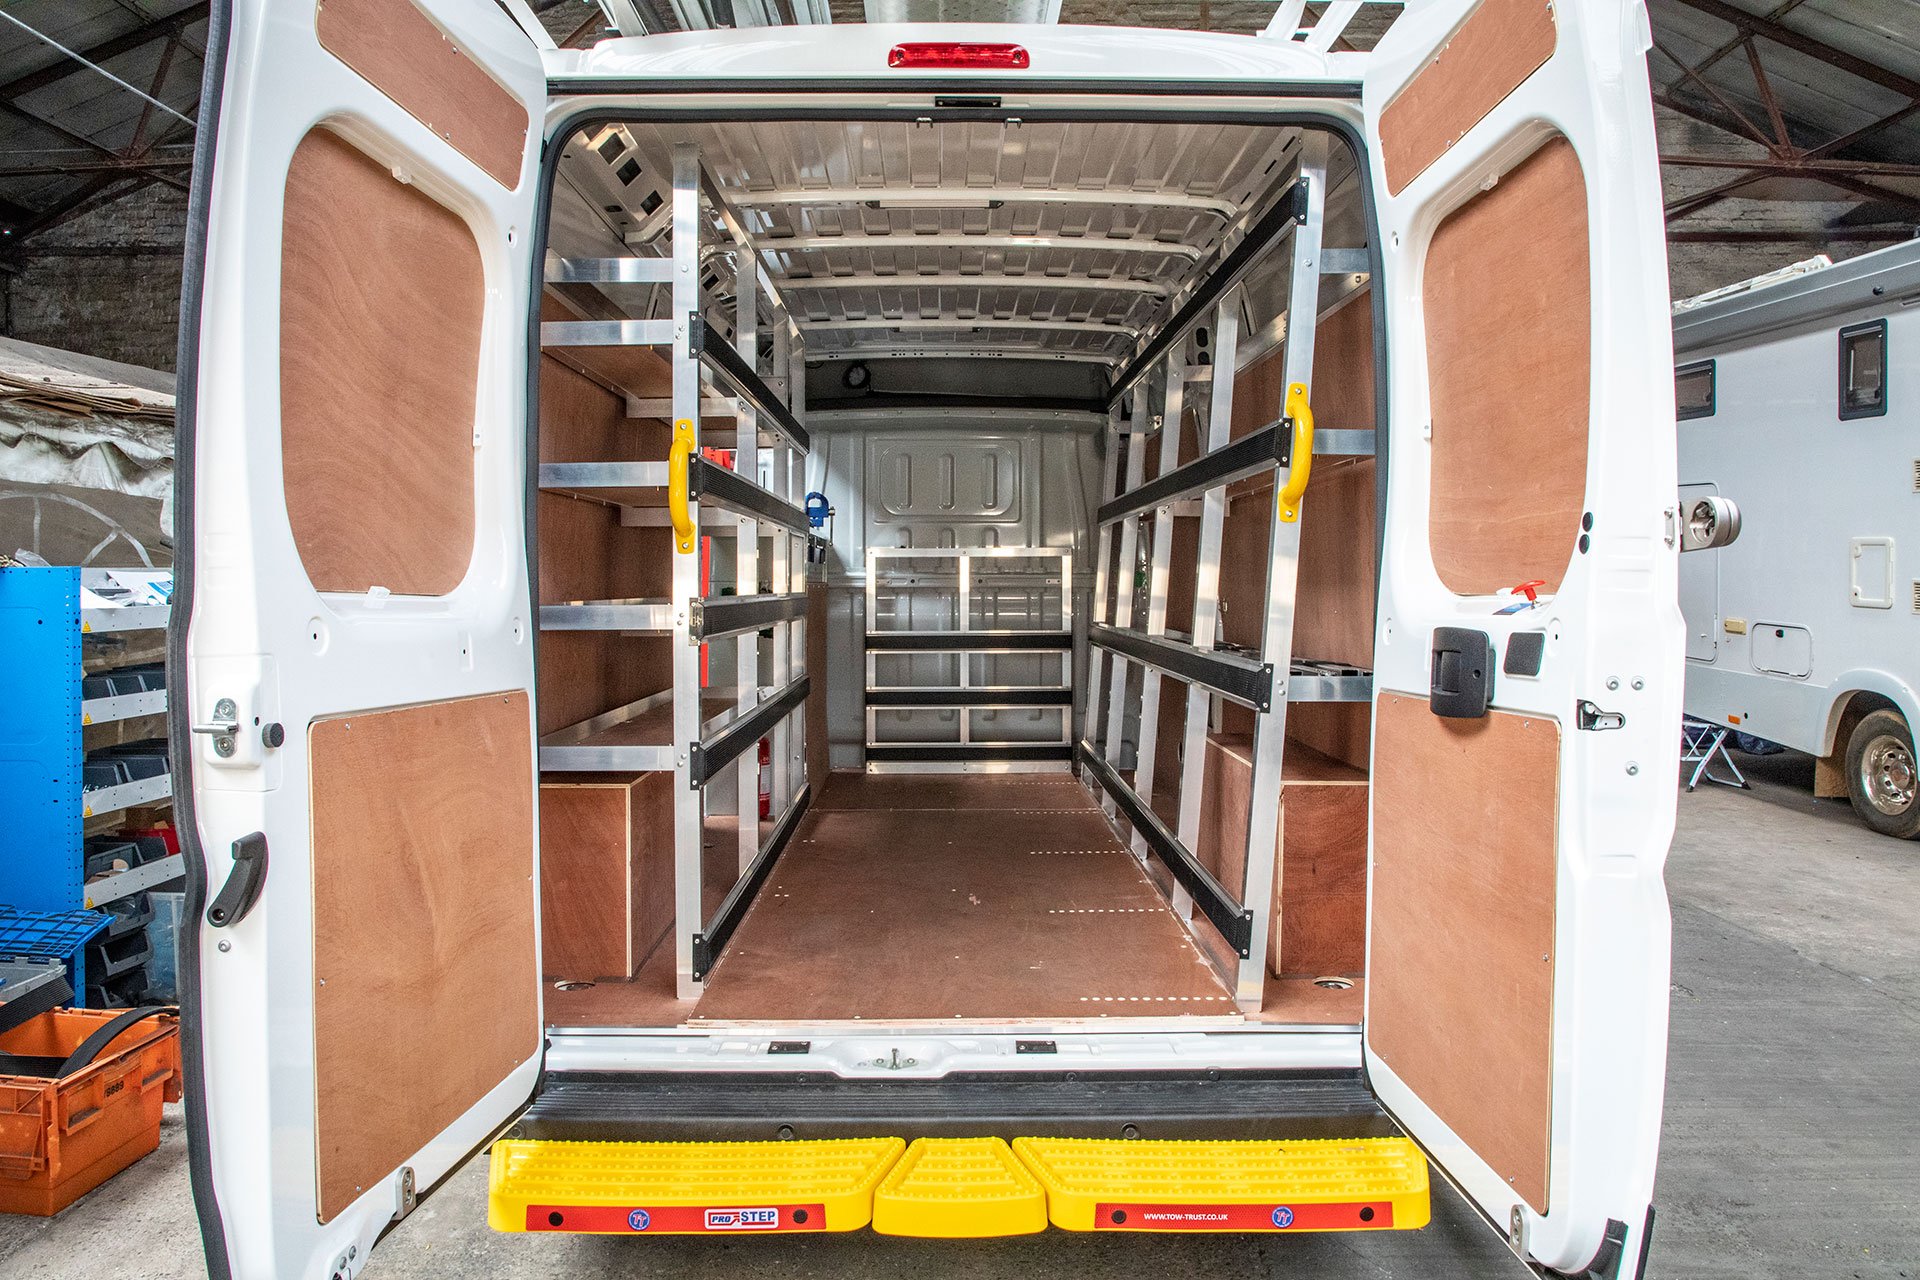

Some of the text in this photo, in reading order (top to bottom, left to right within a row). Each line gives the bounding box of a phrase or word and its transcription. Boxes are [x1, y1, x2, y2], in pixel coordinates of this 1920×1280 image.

[711, 1211, 776, 1223] PRO STEP
[1144, 1213, 1228, 1221] WWW.TOW-TRUST.CO.UK
